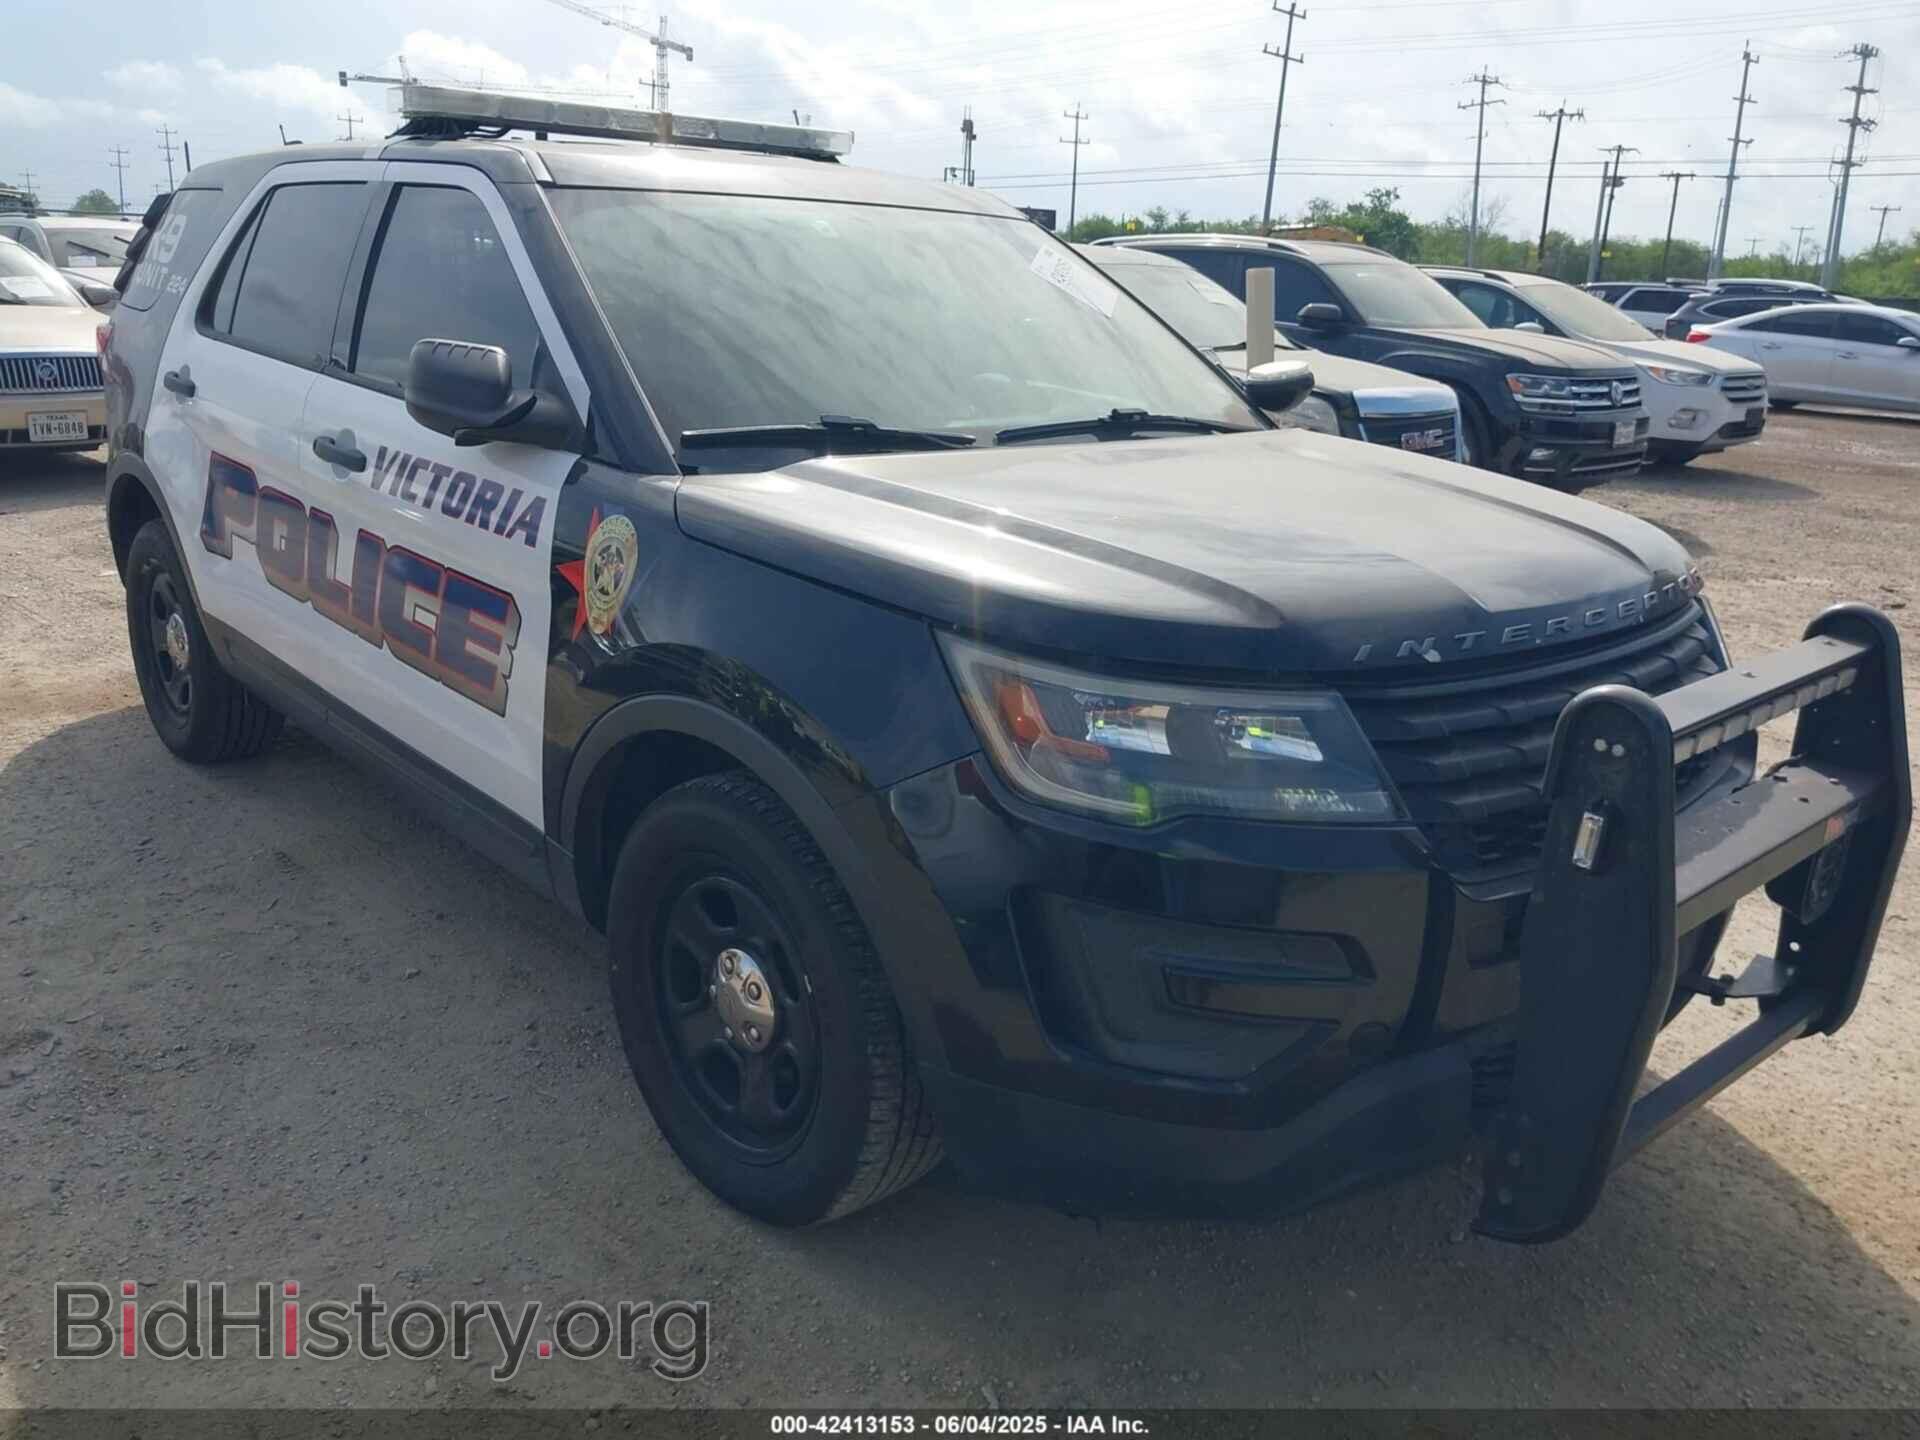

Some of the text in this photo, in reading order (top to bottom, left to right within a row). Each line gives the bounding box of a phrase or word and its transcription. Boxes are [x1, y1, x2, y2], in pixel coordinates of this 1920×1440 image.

[1400, 429, 1444, 450] GMC
[368, 446, 547, 549] VICTORIA
[200, 450, 522, 718] POLICE
